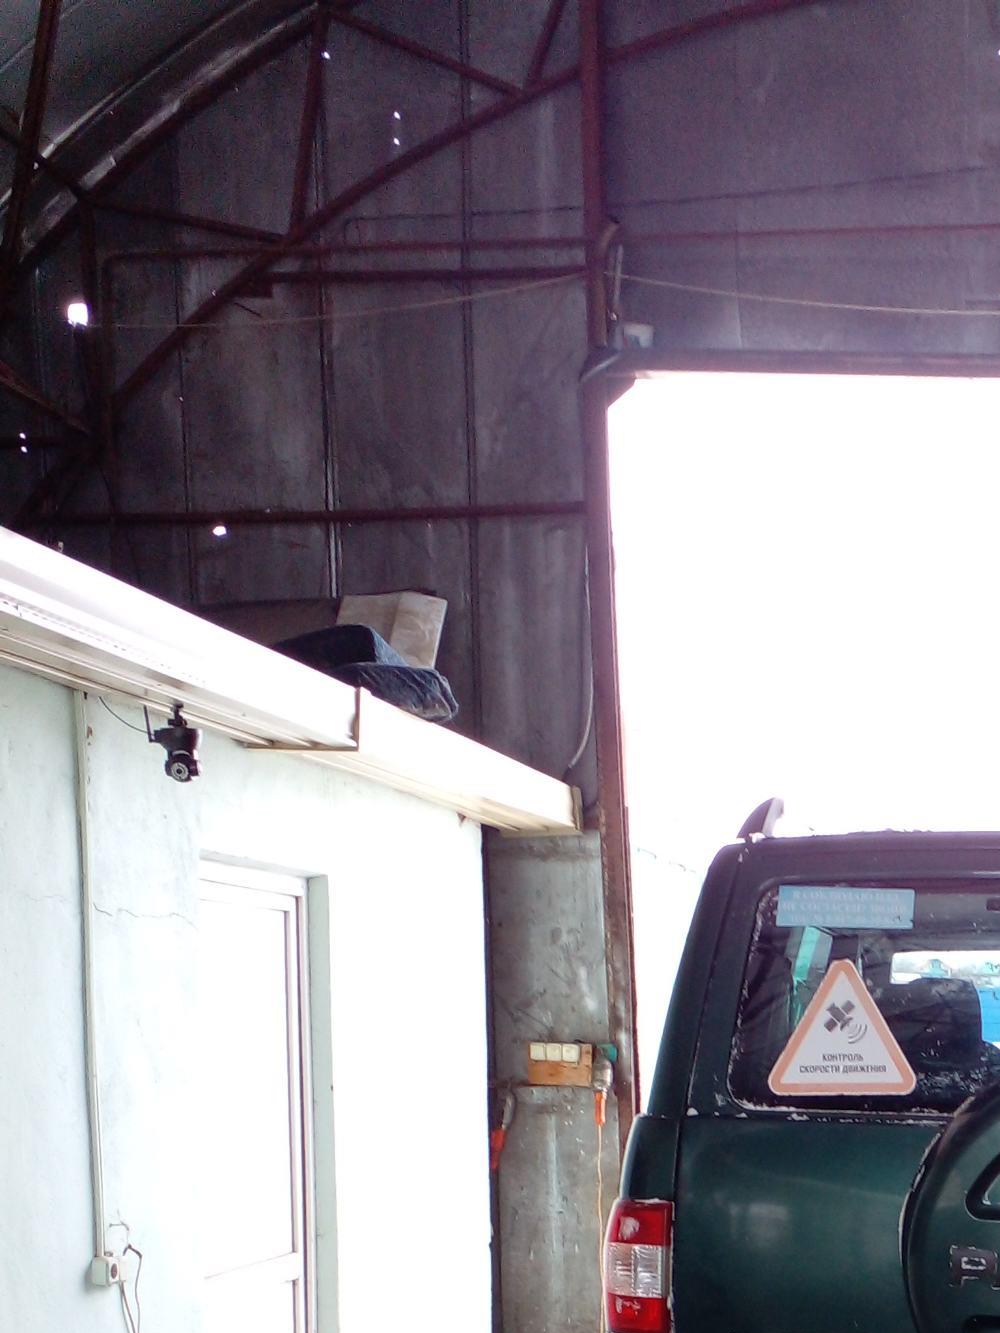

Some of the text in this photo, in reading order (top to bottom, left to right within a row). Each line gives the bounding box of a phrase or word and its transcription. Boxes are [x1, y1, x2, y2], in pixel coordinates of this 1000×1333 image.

[821, 1053, 864, 1062] КОНТРОЛЬ
[799, 1065, 887, 1075] СКОРОСТИ ДВИЖЕНИЯ
